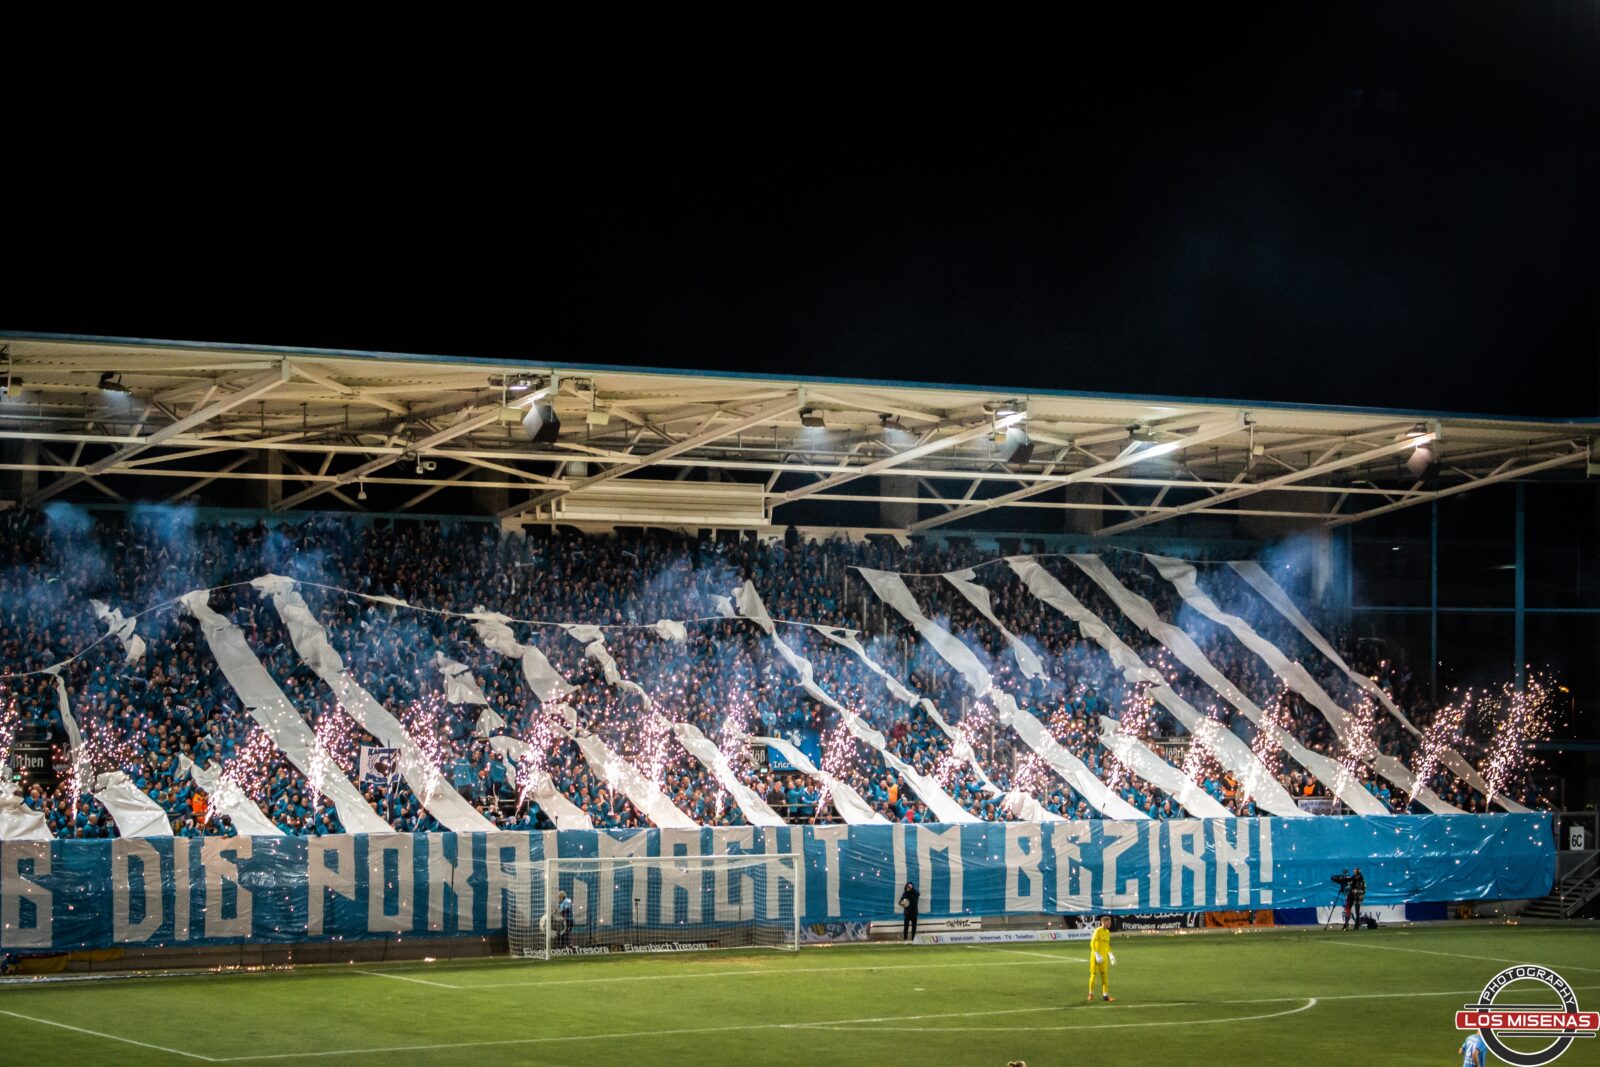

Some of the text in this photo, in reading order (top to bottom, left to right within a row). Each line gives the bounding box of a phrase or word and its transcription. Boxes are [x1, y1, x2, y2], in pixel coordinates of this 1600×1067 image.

[1571, 833, 1583, 847] 6C
[891, 820, 964, 914] IM
[574, 944, 609, 955] Tresore
[624, 942, 672, 953] Eisenbach
[673, 941, 708, 951] Tresore
